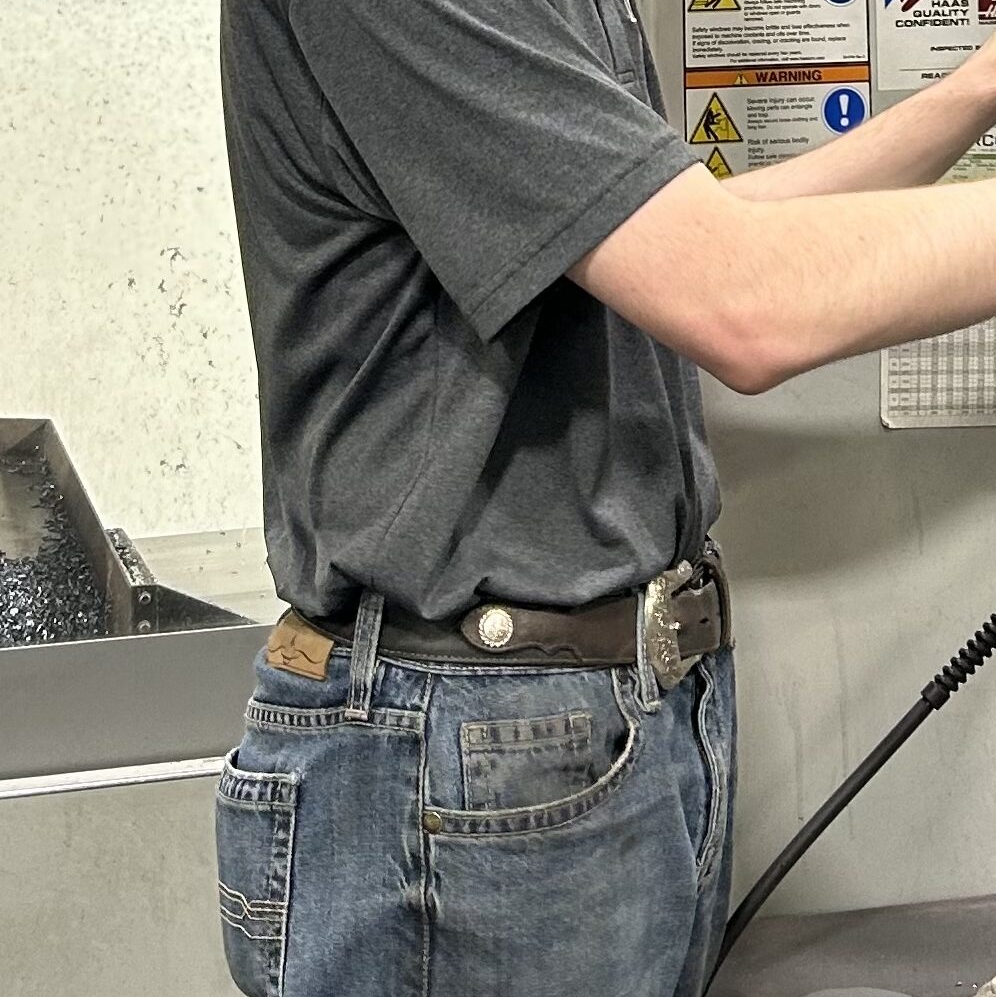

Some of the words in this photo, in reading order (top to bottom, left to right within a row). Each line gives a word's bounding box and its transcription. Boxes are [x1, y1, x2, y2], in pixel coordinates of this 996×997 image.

[913, 9, 969, 17] QUALITY
[896, 19, 970, 27] CONFIDENT!
[755, 70, 822, 83] WARNING
